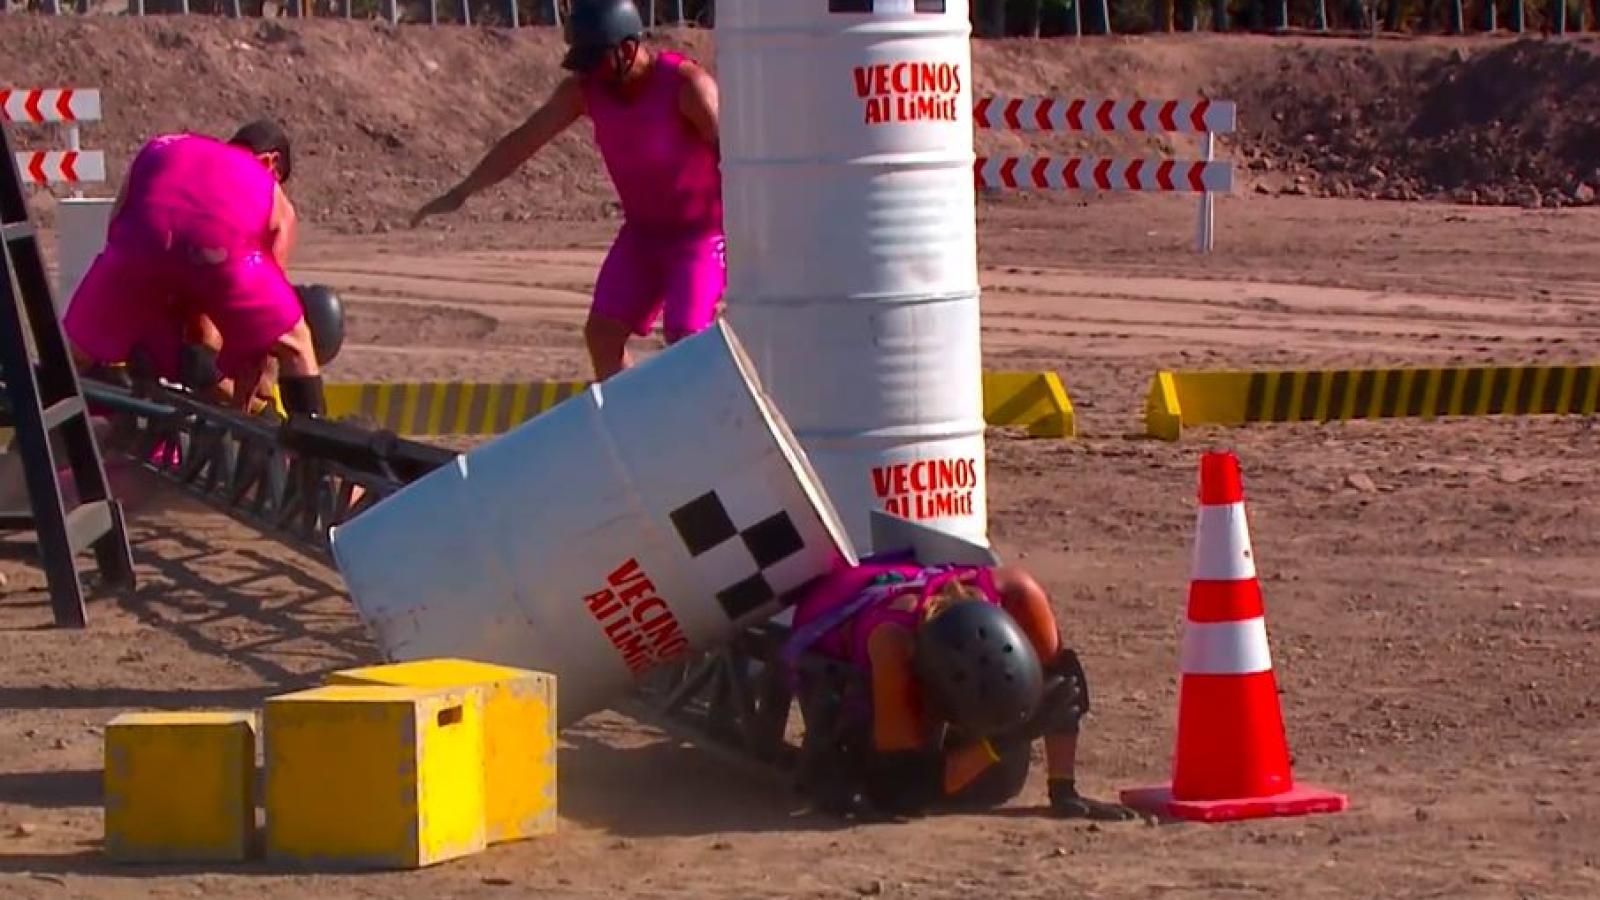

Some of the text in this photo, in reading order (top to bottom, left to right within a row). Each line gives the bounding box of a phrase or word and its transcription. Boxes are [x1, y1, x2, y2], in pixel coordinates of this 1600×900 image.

[853, 62, 961, 97] VECINOS
[872, 458, 977, 497] VECINOS
[607, 557, 692, 664] VECINO
